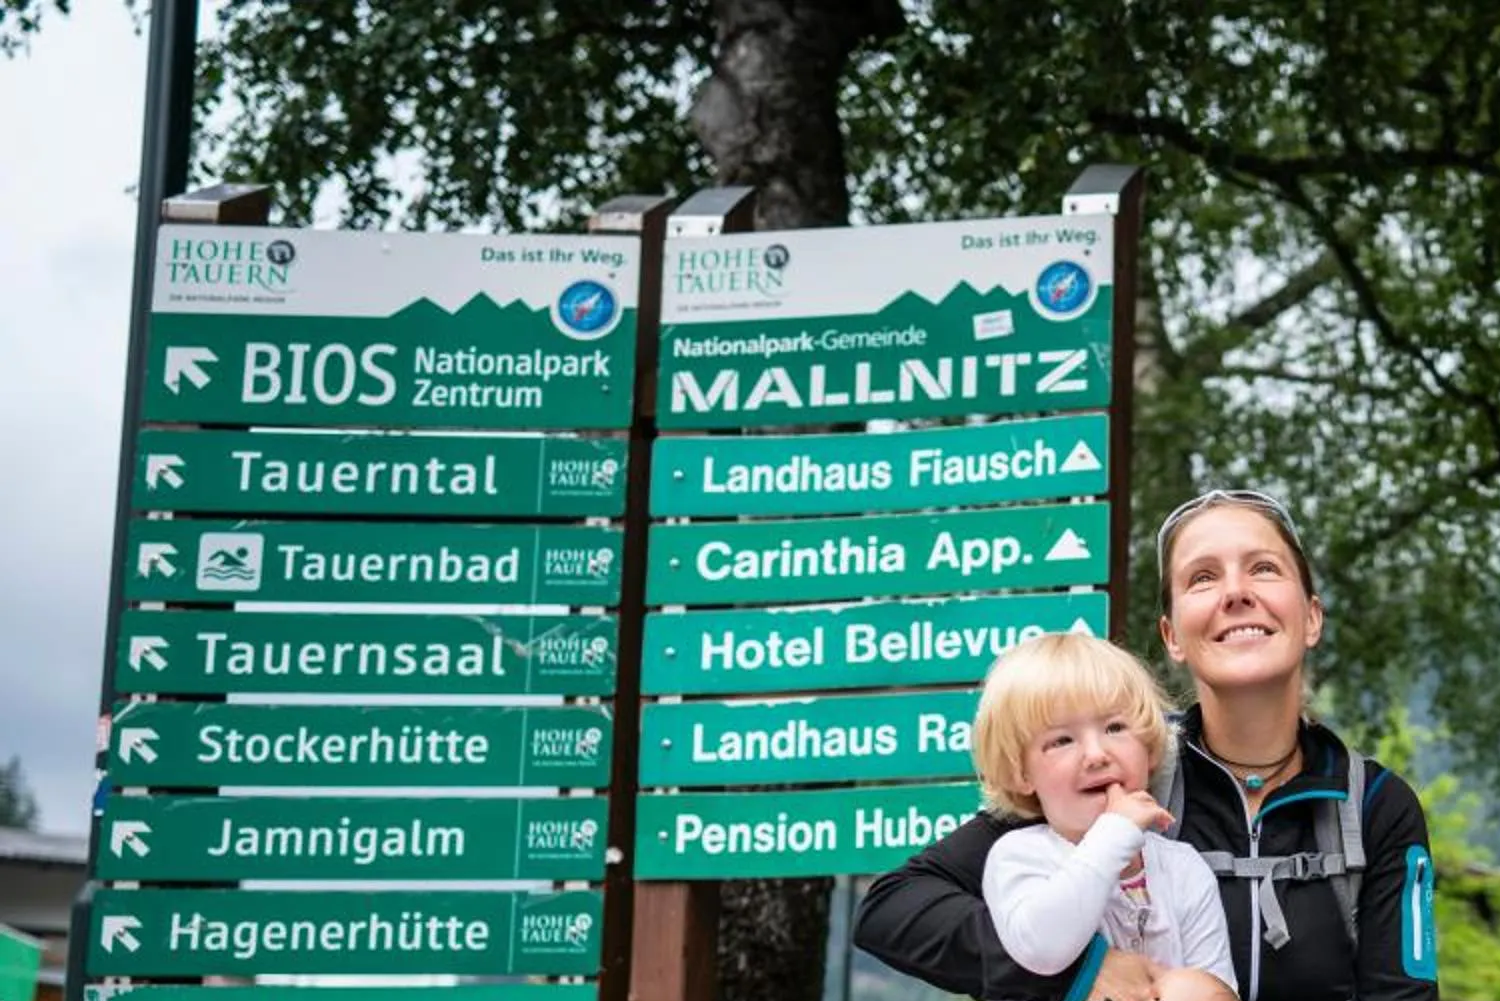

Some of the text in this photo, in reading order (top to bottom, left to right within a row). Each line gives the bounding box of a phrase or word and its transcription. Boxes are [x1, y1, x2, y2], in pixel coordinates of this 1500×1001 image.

[172, 239, 264, 261] HOHE
[481, 247, 627, 267] Das ist Ihr Weg.
[961, 228, 1102, 249] Das ist Ihr Weg.
[166, 263, 297, 294] TAUERN
[679, 247, 761, 271] HOHE
[674, 270, 790, 298] TAUERN
[673, 326, 927, 358] Nationalpark-Gemeinde
[241, 342, 610, 406] BIOS Nationalpark
[670, 349, 1089, 413] MALLNITZ
[412, 380, 543, 408] Zentrum
[231, 451, 498, 495] Tauerntal
[703, 455, 892, 493] Landhaus
[278, 545, 519, 583] Tauernbad
[697, 531, 1033, 581] Carinthia App.
[197, 633, 506, 676] Tauernsaal
[701, 624, 824, 671] Hotel
[197, 725, 489, 764] Stockerhütte
[693, 719, 898, 763] Landhaus
[207, 818, 466, 865] Jamnigalm
[675, 805, 986, 854] Pension Hube
[169, 913, 489, 959] Hagenerhütte
